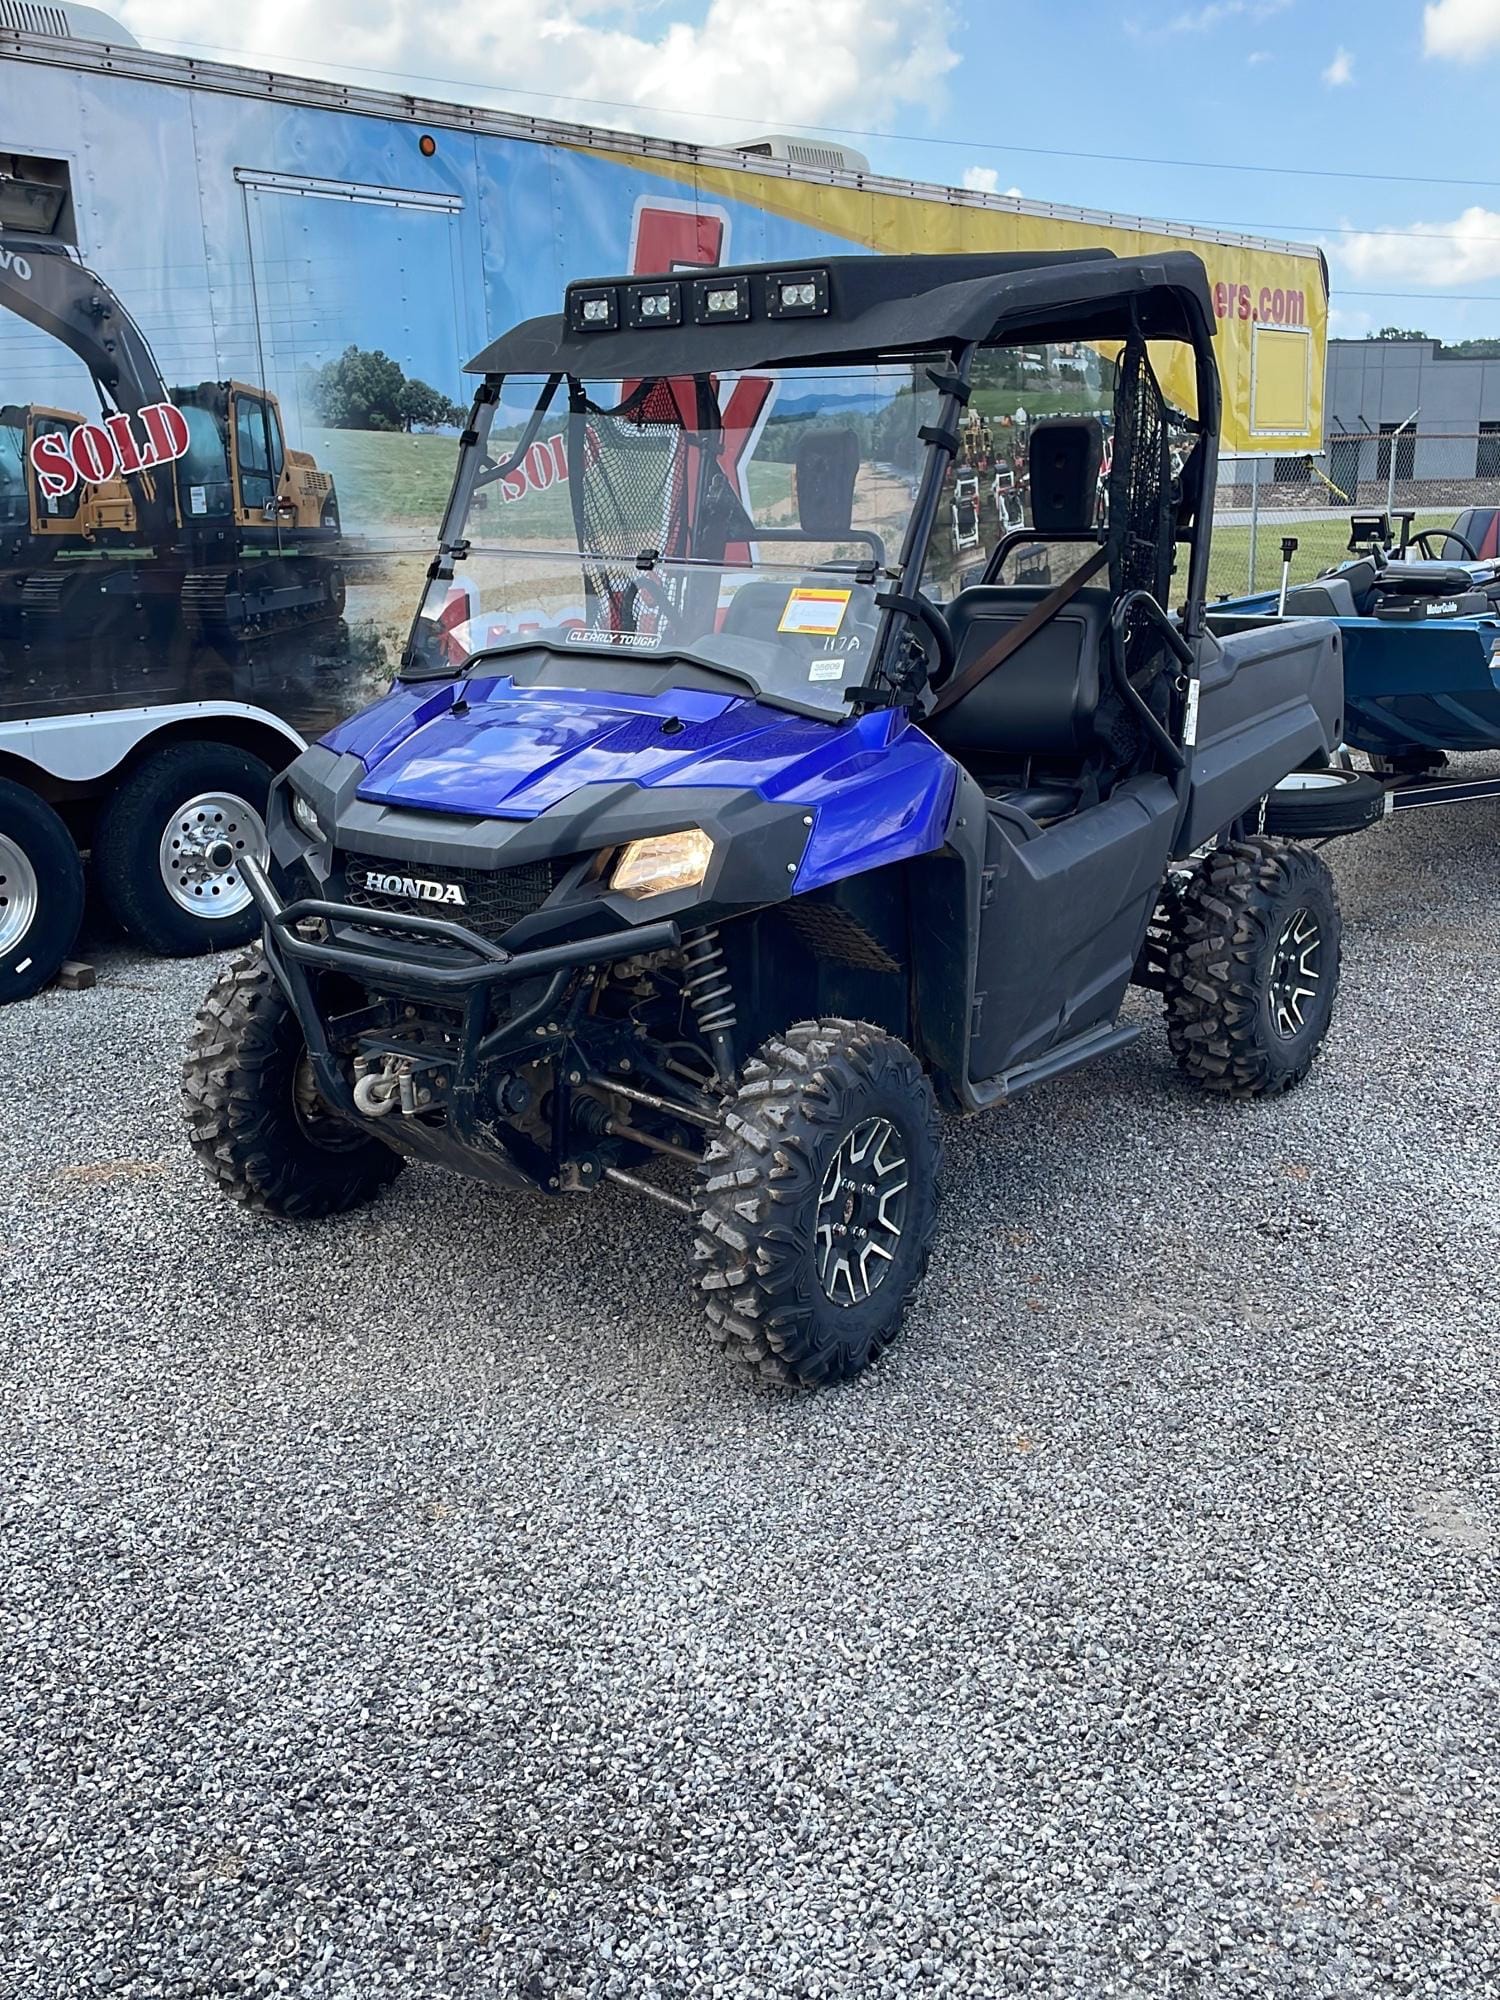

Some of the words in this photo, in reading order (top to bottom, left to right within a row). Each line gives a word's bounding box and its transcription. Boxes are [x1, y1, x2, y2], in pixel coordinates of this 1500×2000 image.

[31, 404, 189, 497] SOLD
[570, 631, 618, 644] CLEARLY
[619, 634, 657, 647] TOUGH
[364, 871, 466, 906] HONDA
